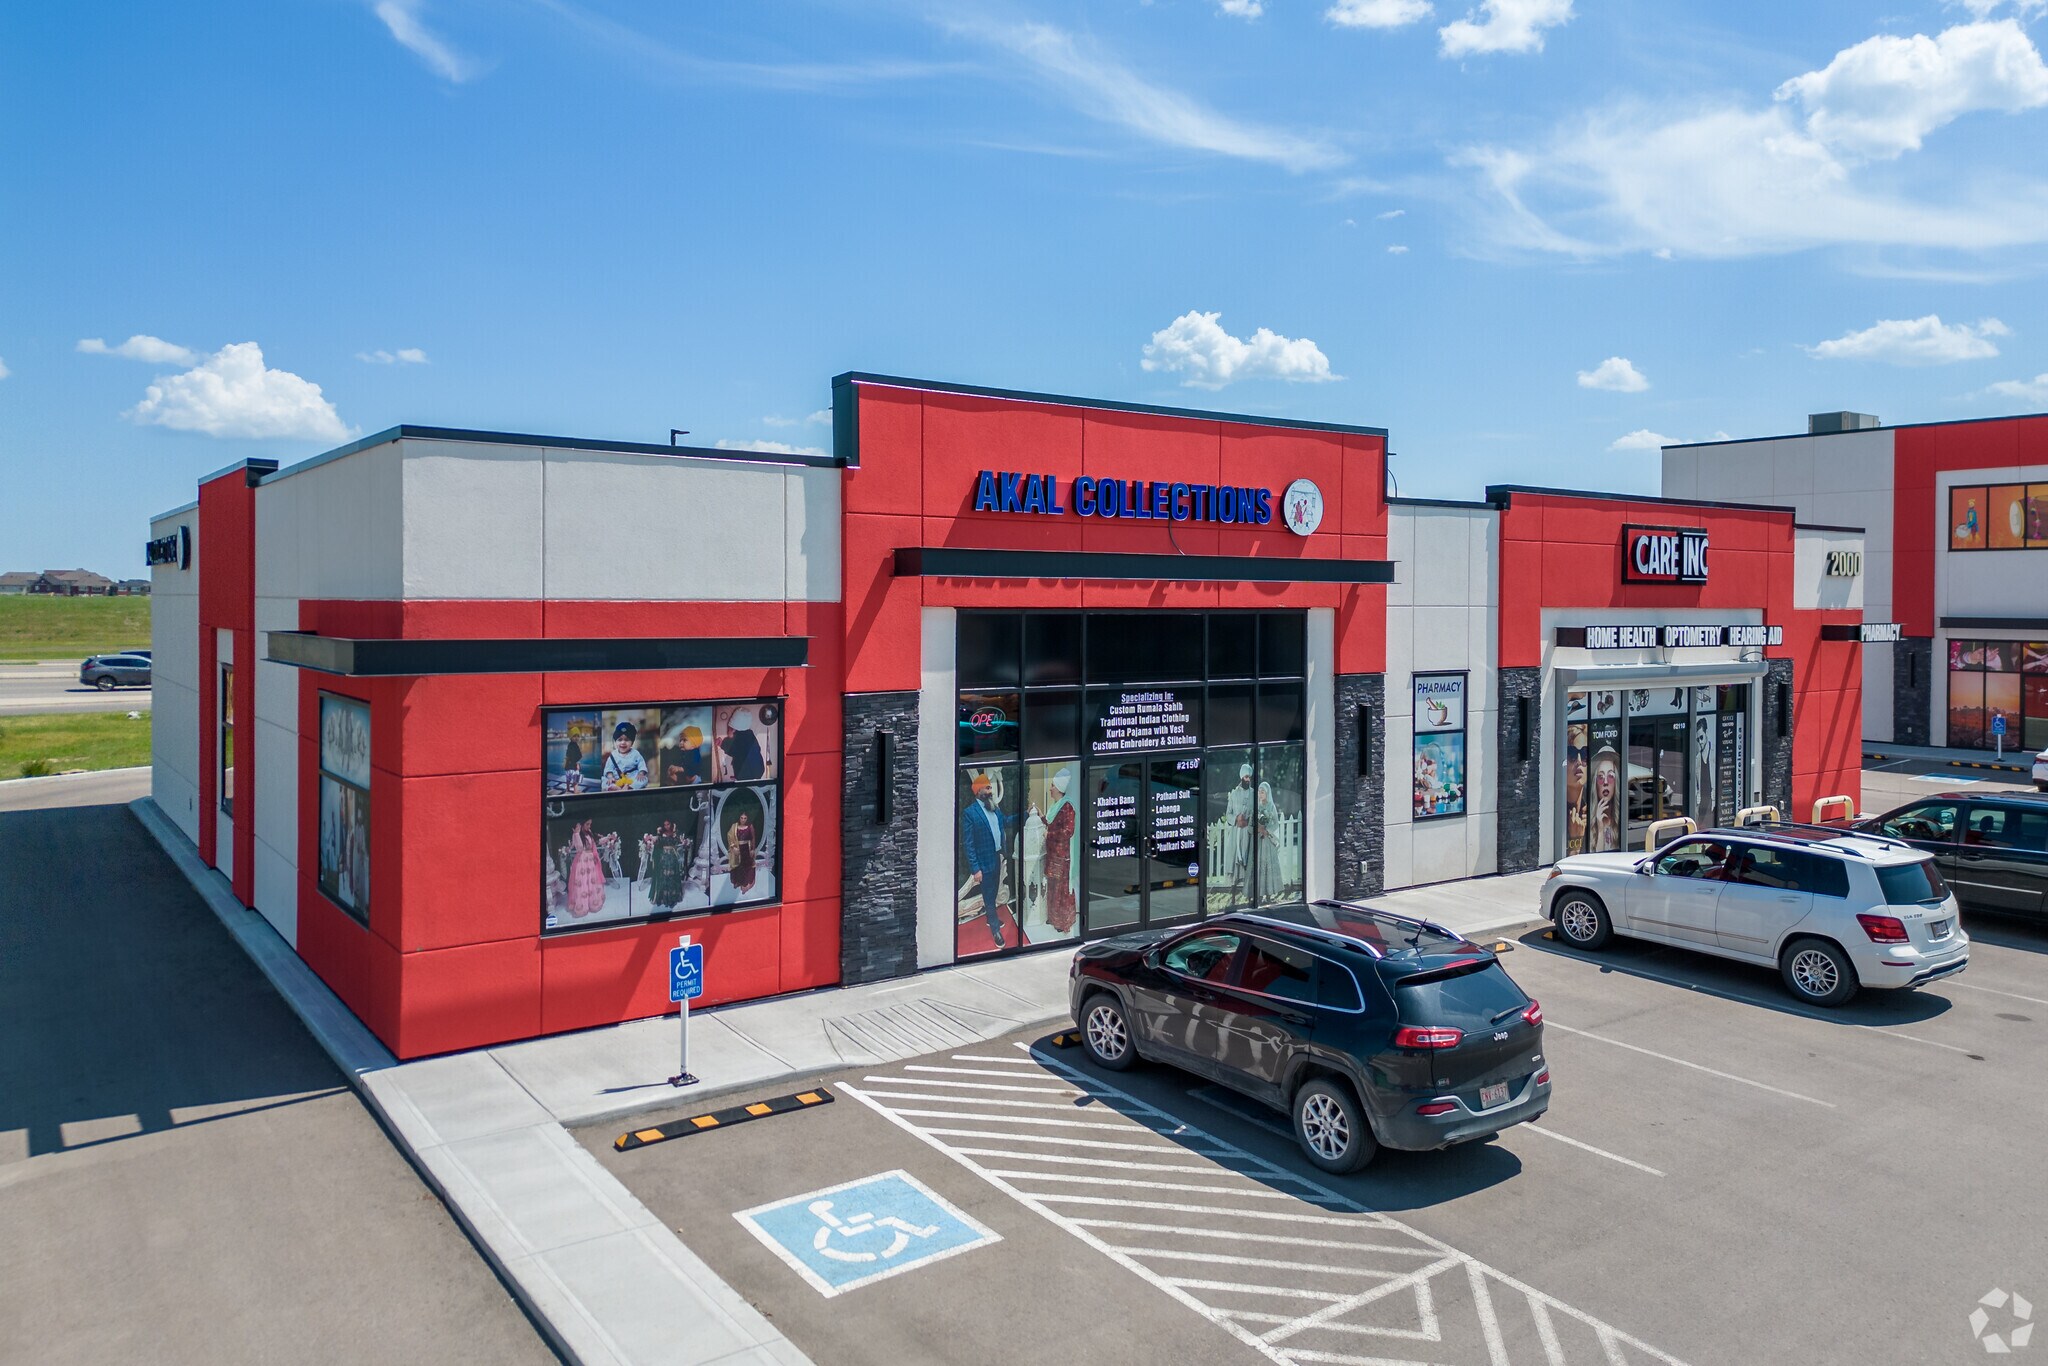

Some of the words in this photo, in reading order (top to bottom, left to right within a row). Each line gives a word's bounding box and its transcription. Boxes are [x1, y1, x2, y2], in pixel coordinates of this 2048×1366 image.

[975, 470, 1064, 515] AKAL
[1075, 476, 1272, 525] COLLECTIONS
[1634, 535, 1680, 575] CARE
[1683, 536, 1709, 576] INC
[1830, 551, 1861, 577] 2000
[1587, 626, 1617, 648] HOME
[1619, 626, 1656, 648] HEALTH
[1665, 626, 1722, 646] OPTOMETRY
[1729, 626, 1766, 646] HEARING
[1768, 626, 1783, 646] AID
[1861, 624, 1901, 642] PHARMACY
[1417, 681, 1462, 694] PHARMACY
[1121, 692, 1163, 704] Specializing
[1109, 705, 1136, 715] Custom
[1137, 704, 1162, 714] Rumala
[1164, 702, 1183, 712] Sahib
[1100, 716, 1138, 727] Traditional
[1139, 715, 1160, 725] Indian
[1161, 713, 1190, 723] Clothing
[1106, 728, 1125, 739] Kurta
[1126, 727, 1152, 738] Pajama
[1153, 725, 1168, 735] with
[1169, 724, 1184, 734] Vest
[1593, 731, 1604, 739] TOM
[1605, 730, 1618, 738] FORD
[1092, 740, 1119, 751] Custom
[1120, 738, 1159, 749] Embroidery
[1160, 737, 1166, 746] &
[1167, 735, 1197, 745] Stitching
[1176, 760, 1199, 770] #2150
[1097, 796, 1118, 807] Khalsa
[1119, 796, 1135, 805] Bana
[1155, 791, 1178, 801] Pathani
[1178, 790, 1191, 799] Suit
[1096, 820, 1126, 831] Shastar's
[1155, 817, 1178, 827] Sharara
[1179, 815, 1194, 824] Suits
[1179, 827, 1194, 837] Suits
[1096, 834, 1122, 845] Jewelry
[1180, 840, 1195, 849] Suits
[1096, 848, 1115, 859] Loose
[1116, 846, 1136, 856] Fabric
[676, 978, 697, 988] PERMIT
[672, 986, 701, 997] REQUIRED
[1493, 1031, 1509, 1041] Jeep
